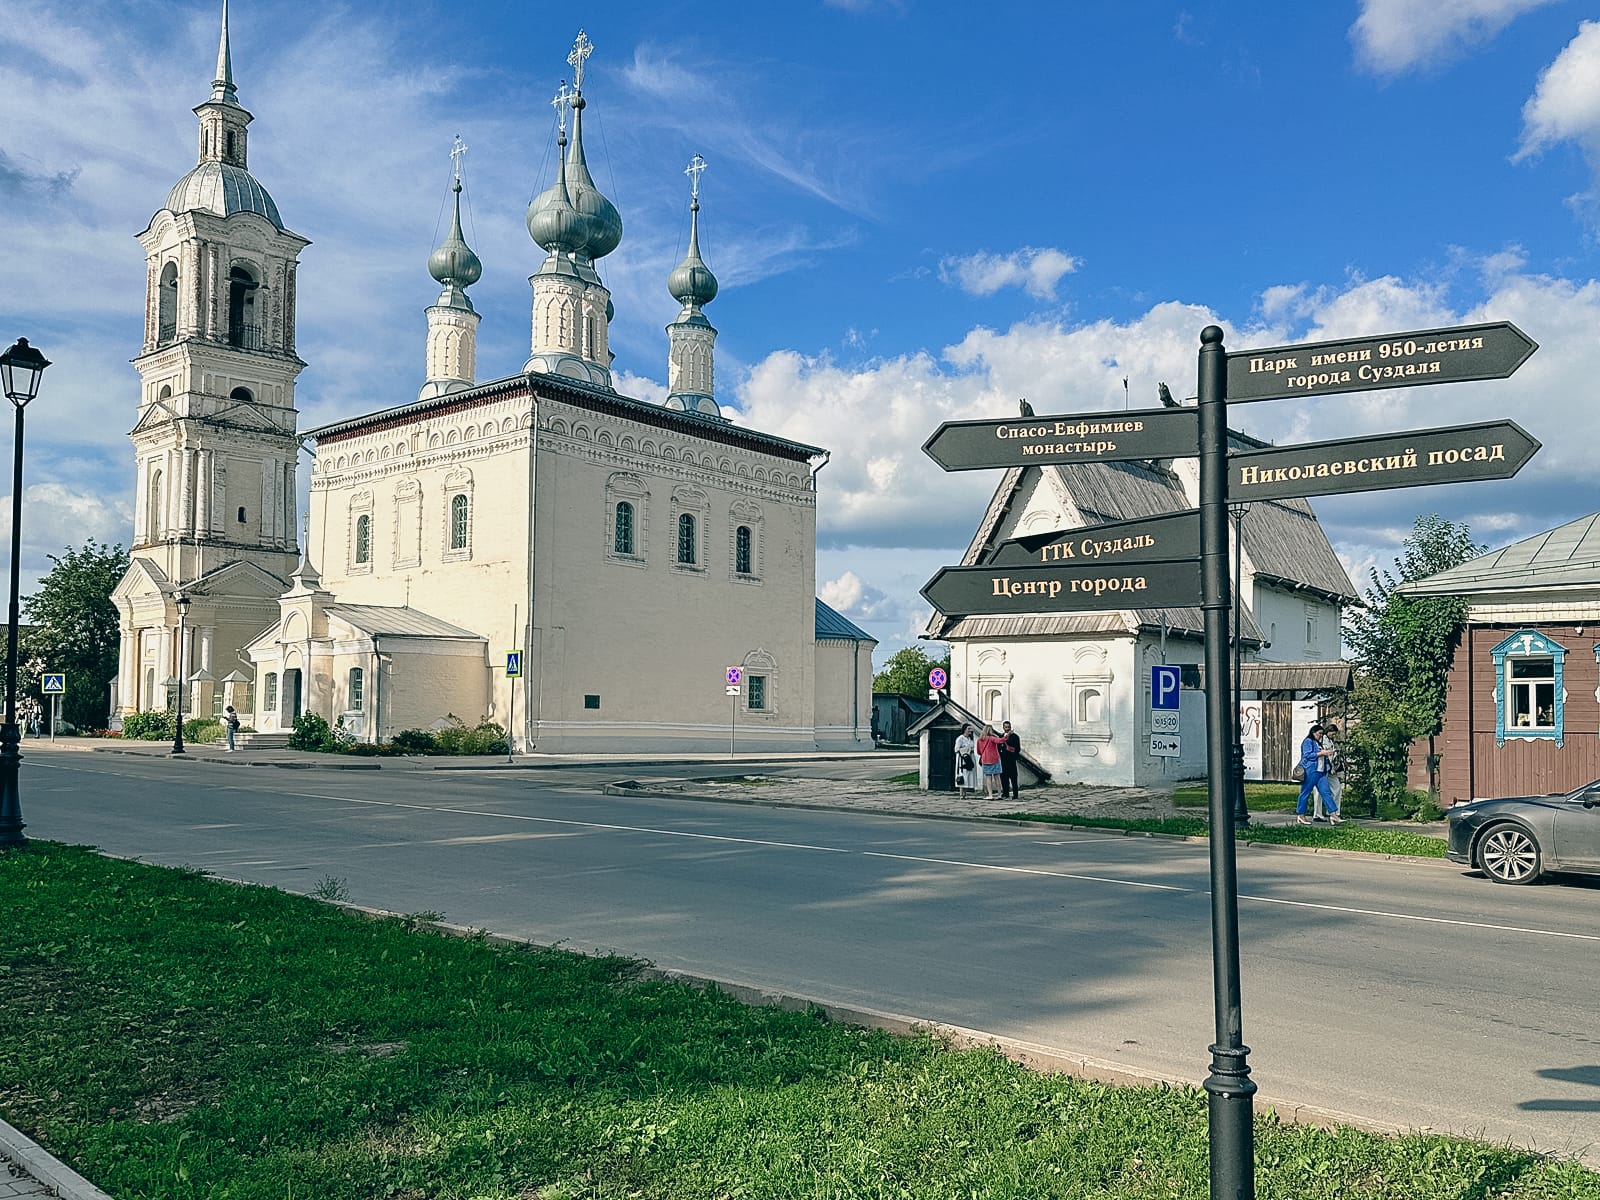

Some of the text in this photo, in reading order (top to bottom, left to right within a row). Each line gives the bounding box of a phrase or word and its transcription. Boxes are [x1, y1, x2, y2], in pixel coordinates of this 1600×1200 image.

[1249, 337, 1483, 374] Парк имени 950-летия
[1287, 361, 1441, 390] города Суздаля
[996, 421, 1144, 439] Спасо-Евфимиев
[1022, 440, 1117, 456] монастырь
[1240, 444, 1505, 486] Николаевский посад
[1040, 533, 1155, 562] ГТК Суздаль
[991, 576, 1148, 598] Центр города
[1159, 670, 1176, 705] P
[1168, 717, 1177, 726] 20
